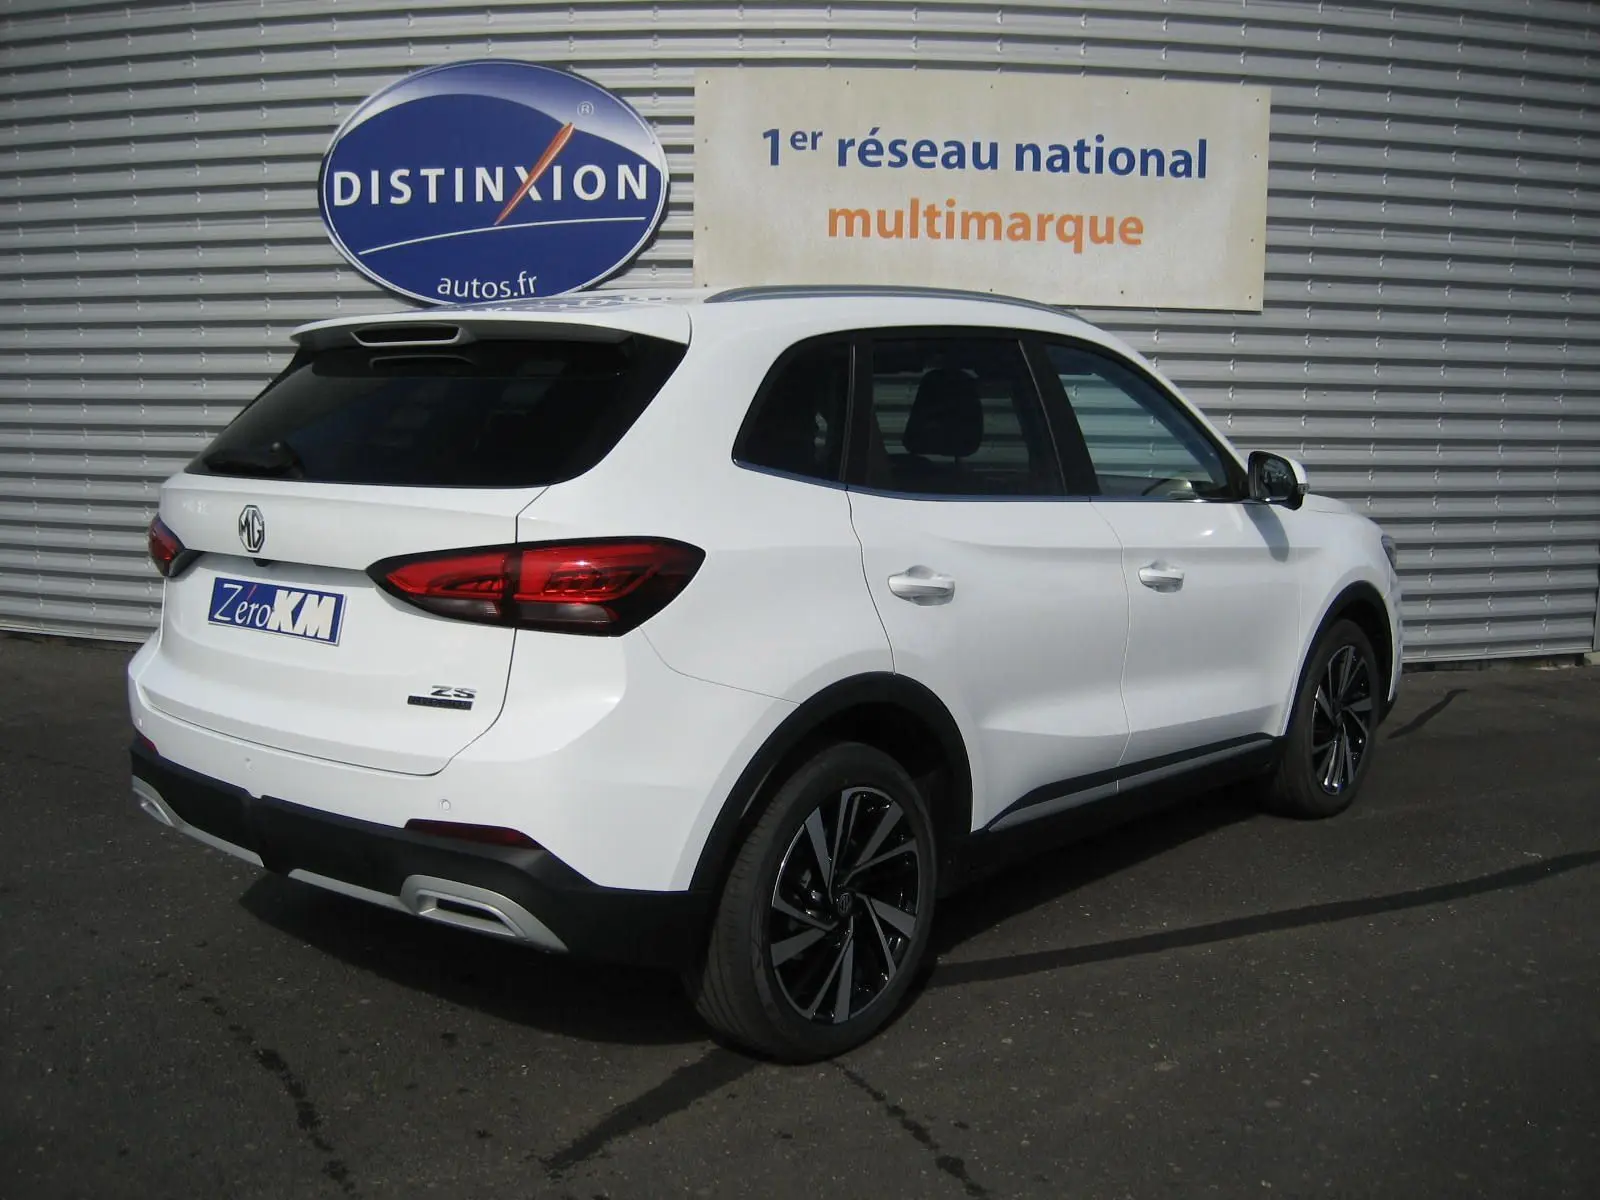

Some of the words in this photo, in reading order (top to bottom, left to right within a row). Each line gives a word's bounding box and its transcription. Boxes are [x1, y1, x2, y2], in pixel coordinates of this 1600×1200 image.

[837, 127, 998, 170] réseau
[1015, 135, 1207, 179] national
[333, 163, 648, 207] DISTINXION
[828, 198, 1144, 254] multimarque
[437, 271, 538, 299] autos.fr
[240, 506, 264, 552] MG
[431, 685, 477, 699] ZS
